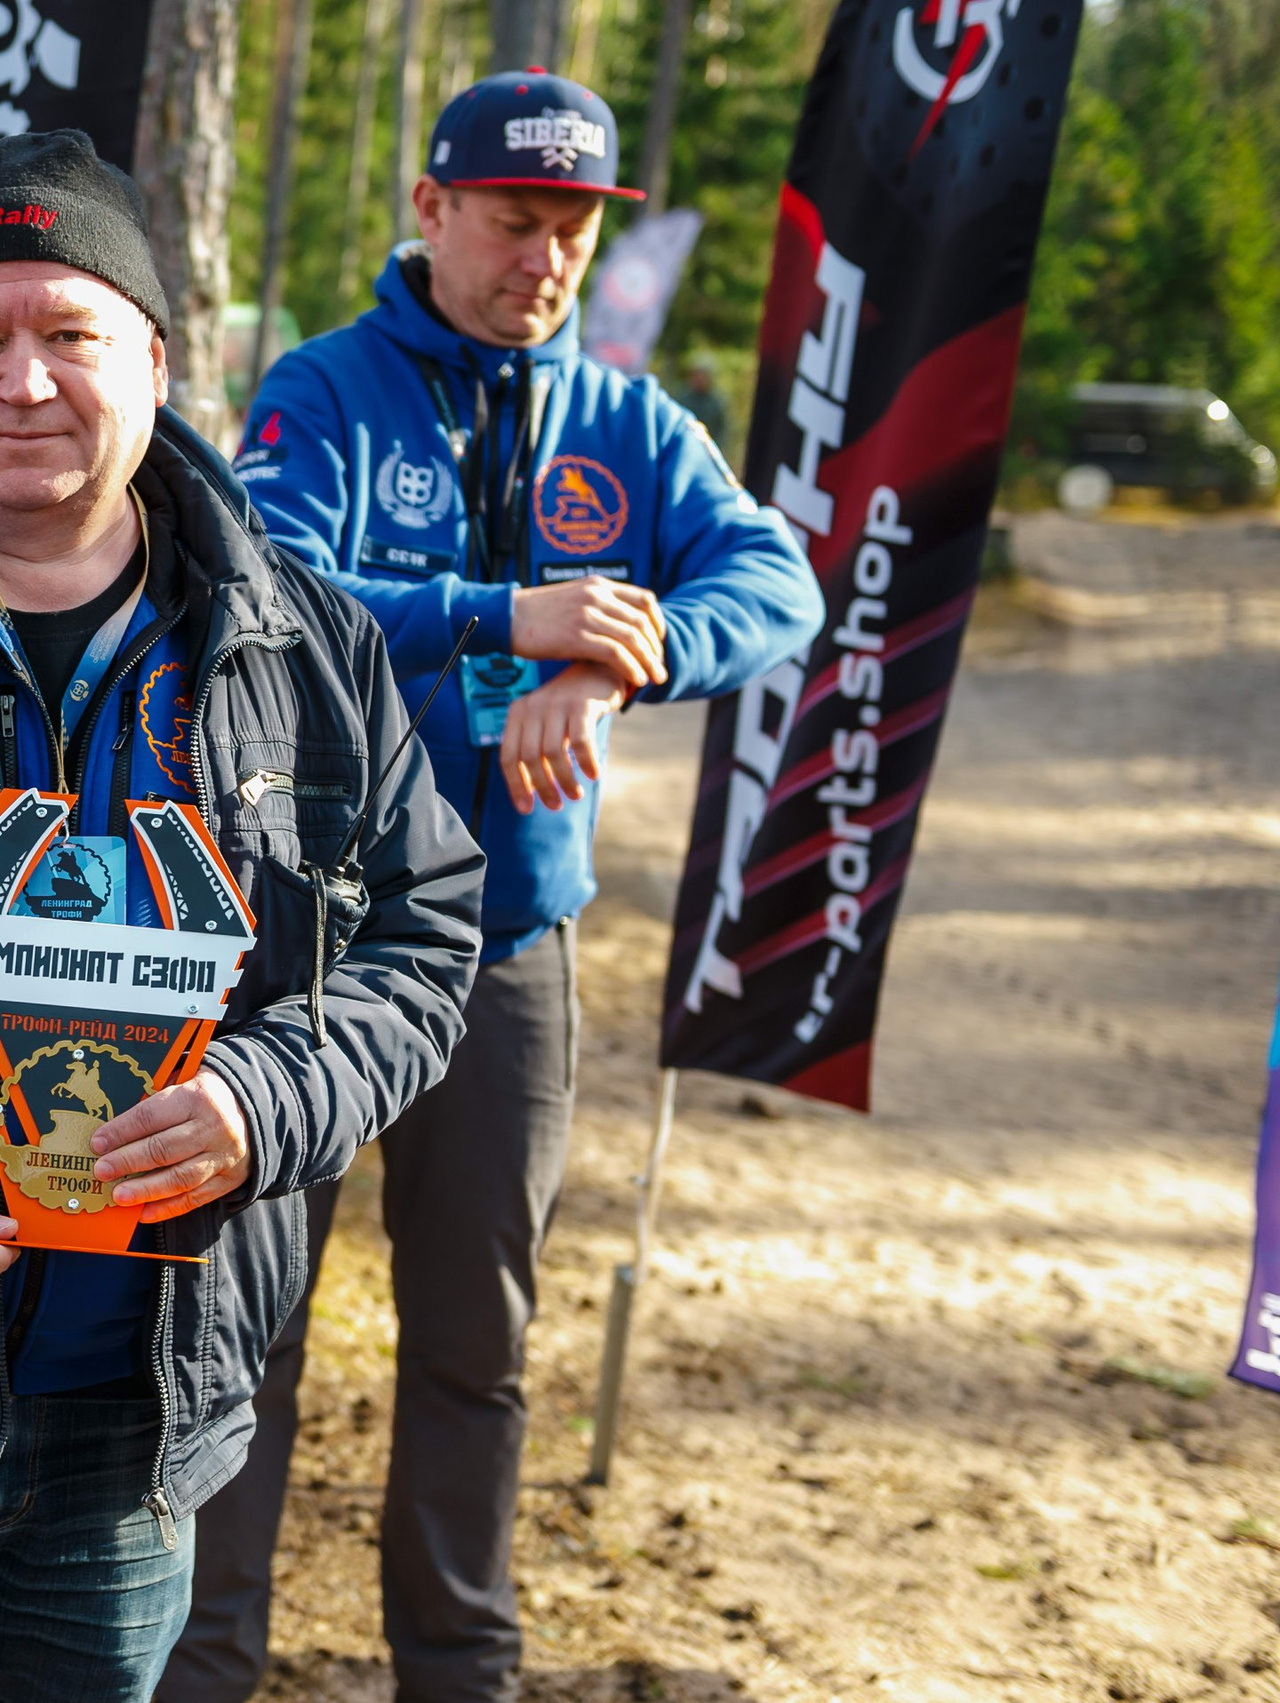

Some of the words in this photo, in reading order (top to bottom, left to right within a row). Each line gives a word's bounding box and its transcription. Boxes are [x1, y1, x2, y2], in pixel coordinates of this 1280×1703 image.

[504, 116, 606, 158] SIBERIA
[684, 241, 866, 1013] TROHY
[40, 899, 93, 909] ЛЕНИНГРАД
[50, 910, 83, 919] ТРОФИ
[131, 954, 217, 994] СЗФО
[1, 1012, 117, 1042] ТРОФИ-РЕЙД
[124, 1024, 170, 1044] 2024
[26, 1151, 102, 1173] ЛЕНИНГ
[47, 1176, 104, 1195] ТРОФИ
